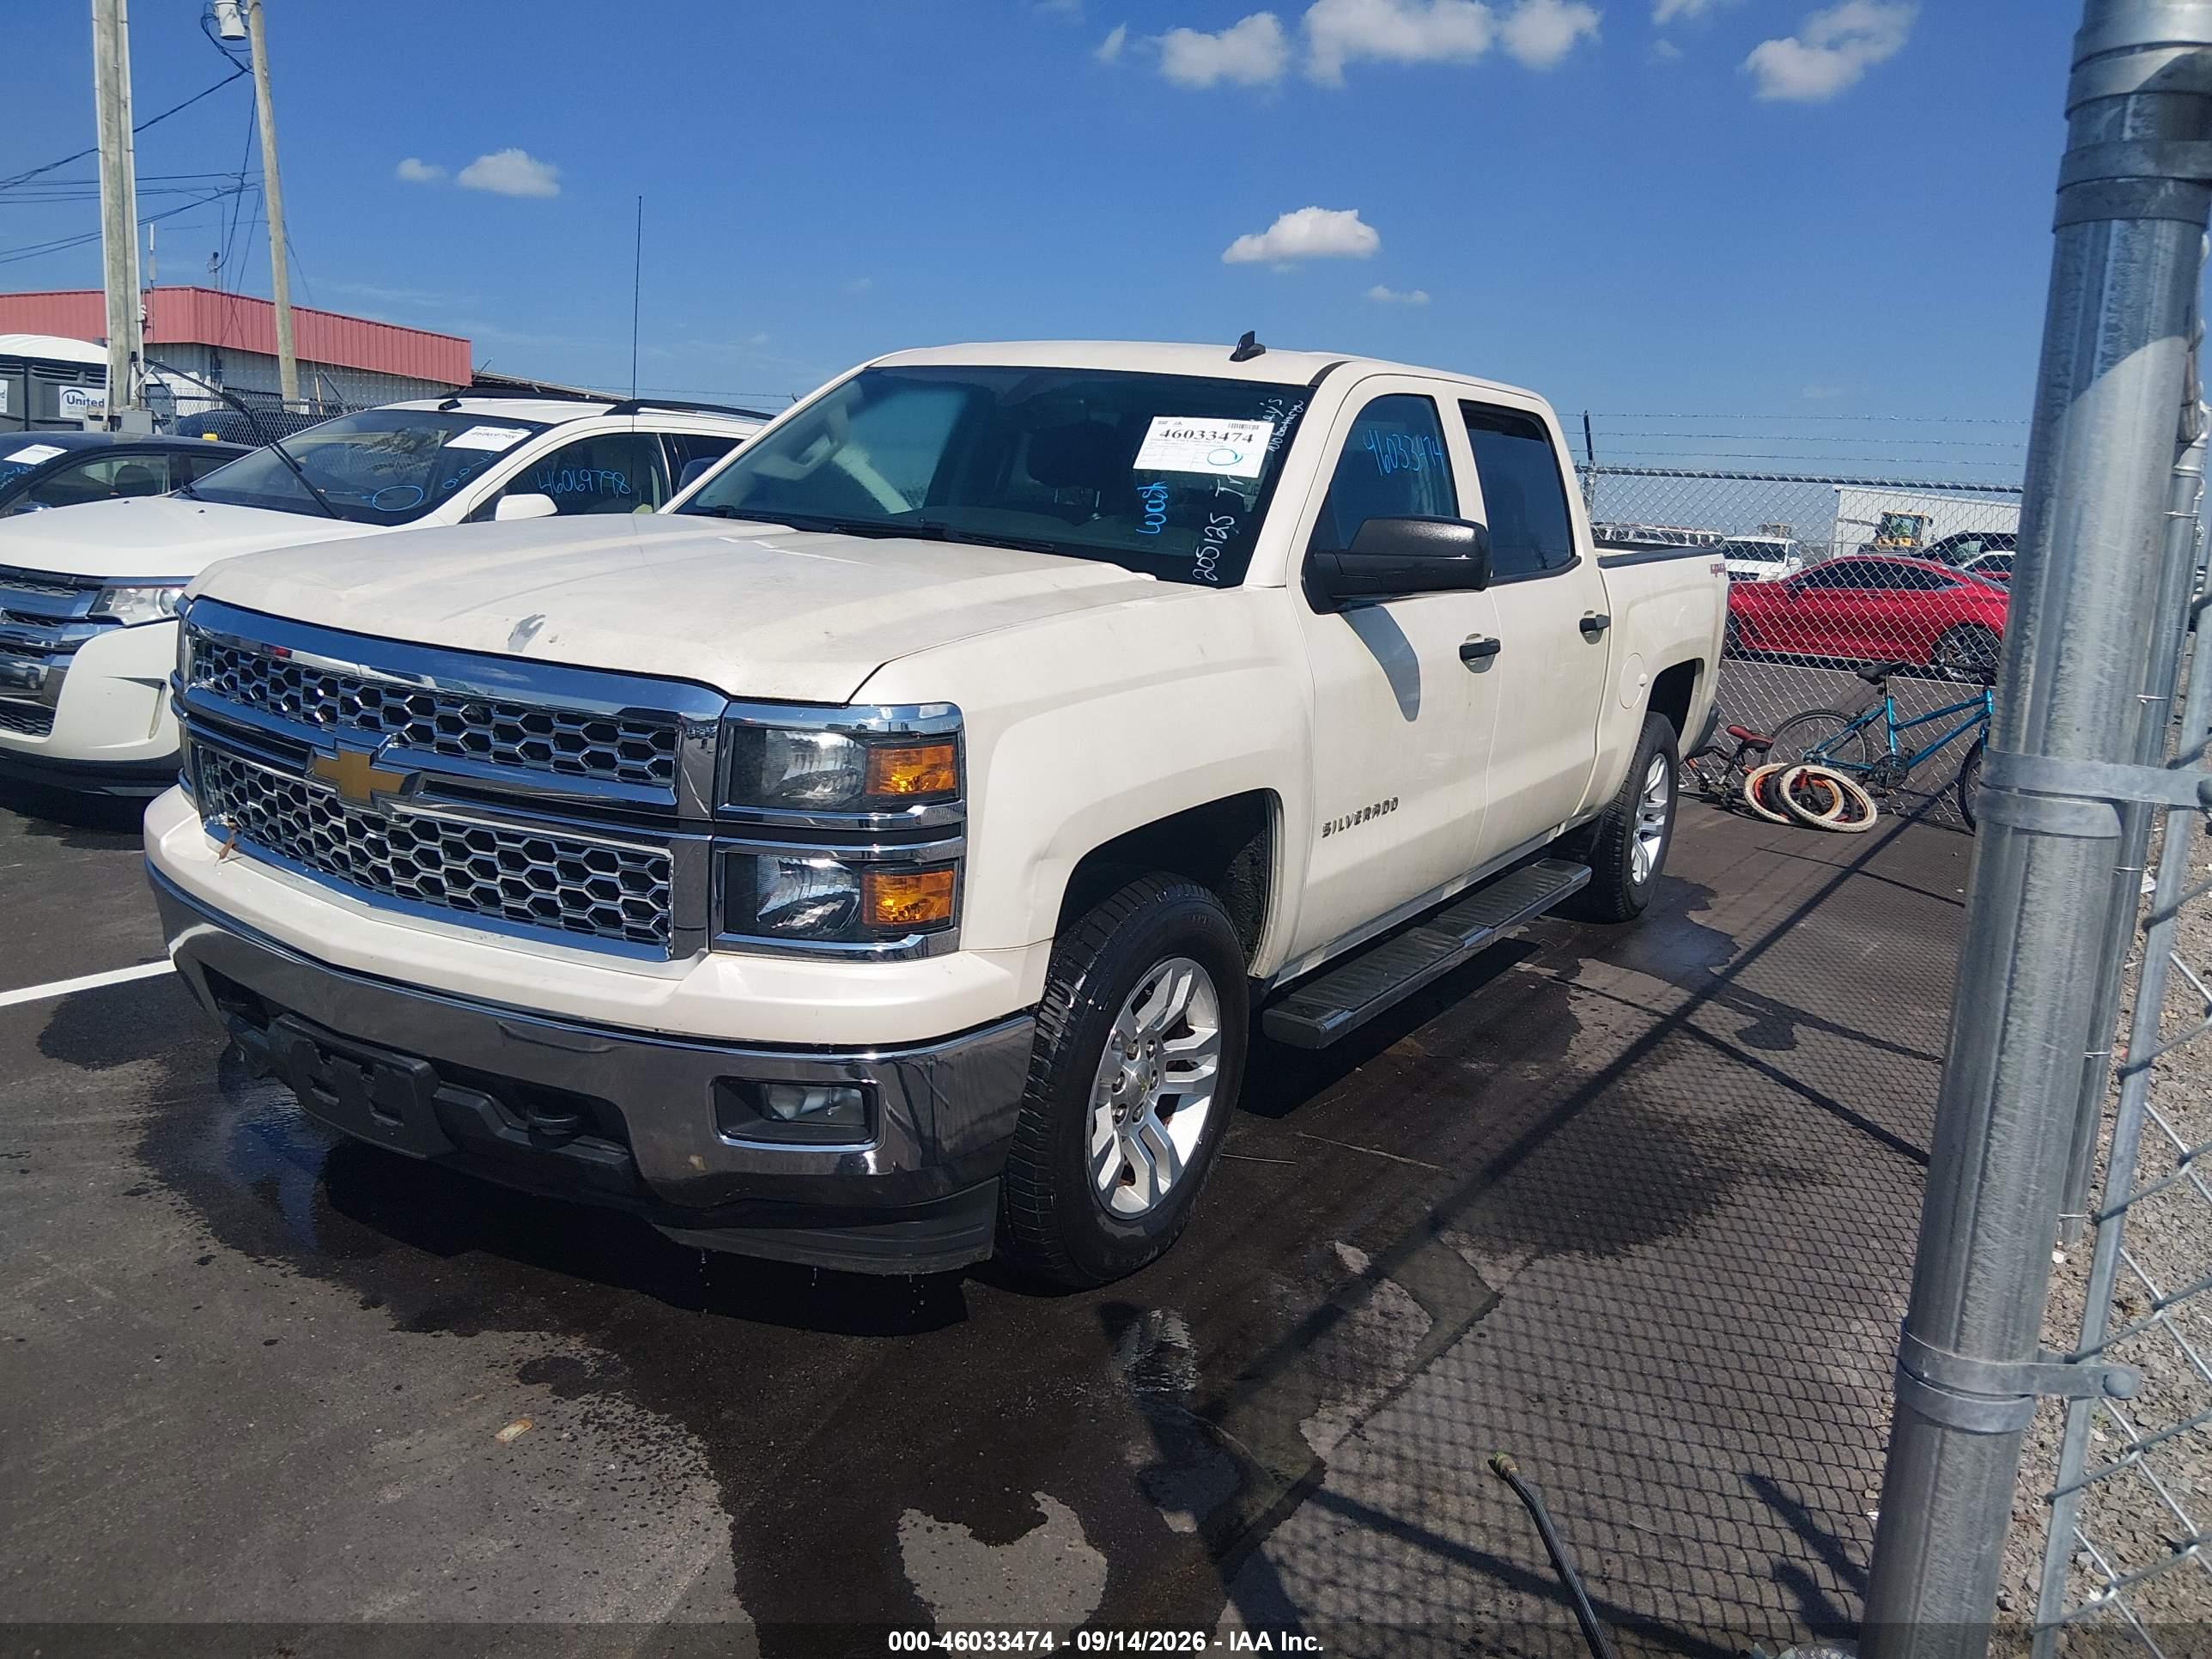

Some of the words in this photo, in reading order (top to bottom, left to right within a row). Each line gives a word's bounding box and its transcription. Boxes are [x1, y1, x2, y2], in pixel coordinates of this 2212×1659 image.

[66, 394, 105, 407] United
[1159, 428, 1254, 443] 46033474
[1363, 428, 1445, 477] 46033474
[537, 469, 631, 495] 46069798
[1192, 512, 1236, 582] 205125
[1322, 796, 1400, 838] SILVERADO
